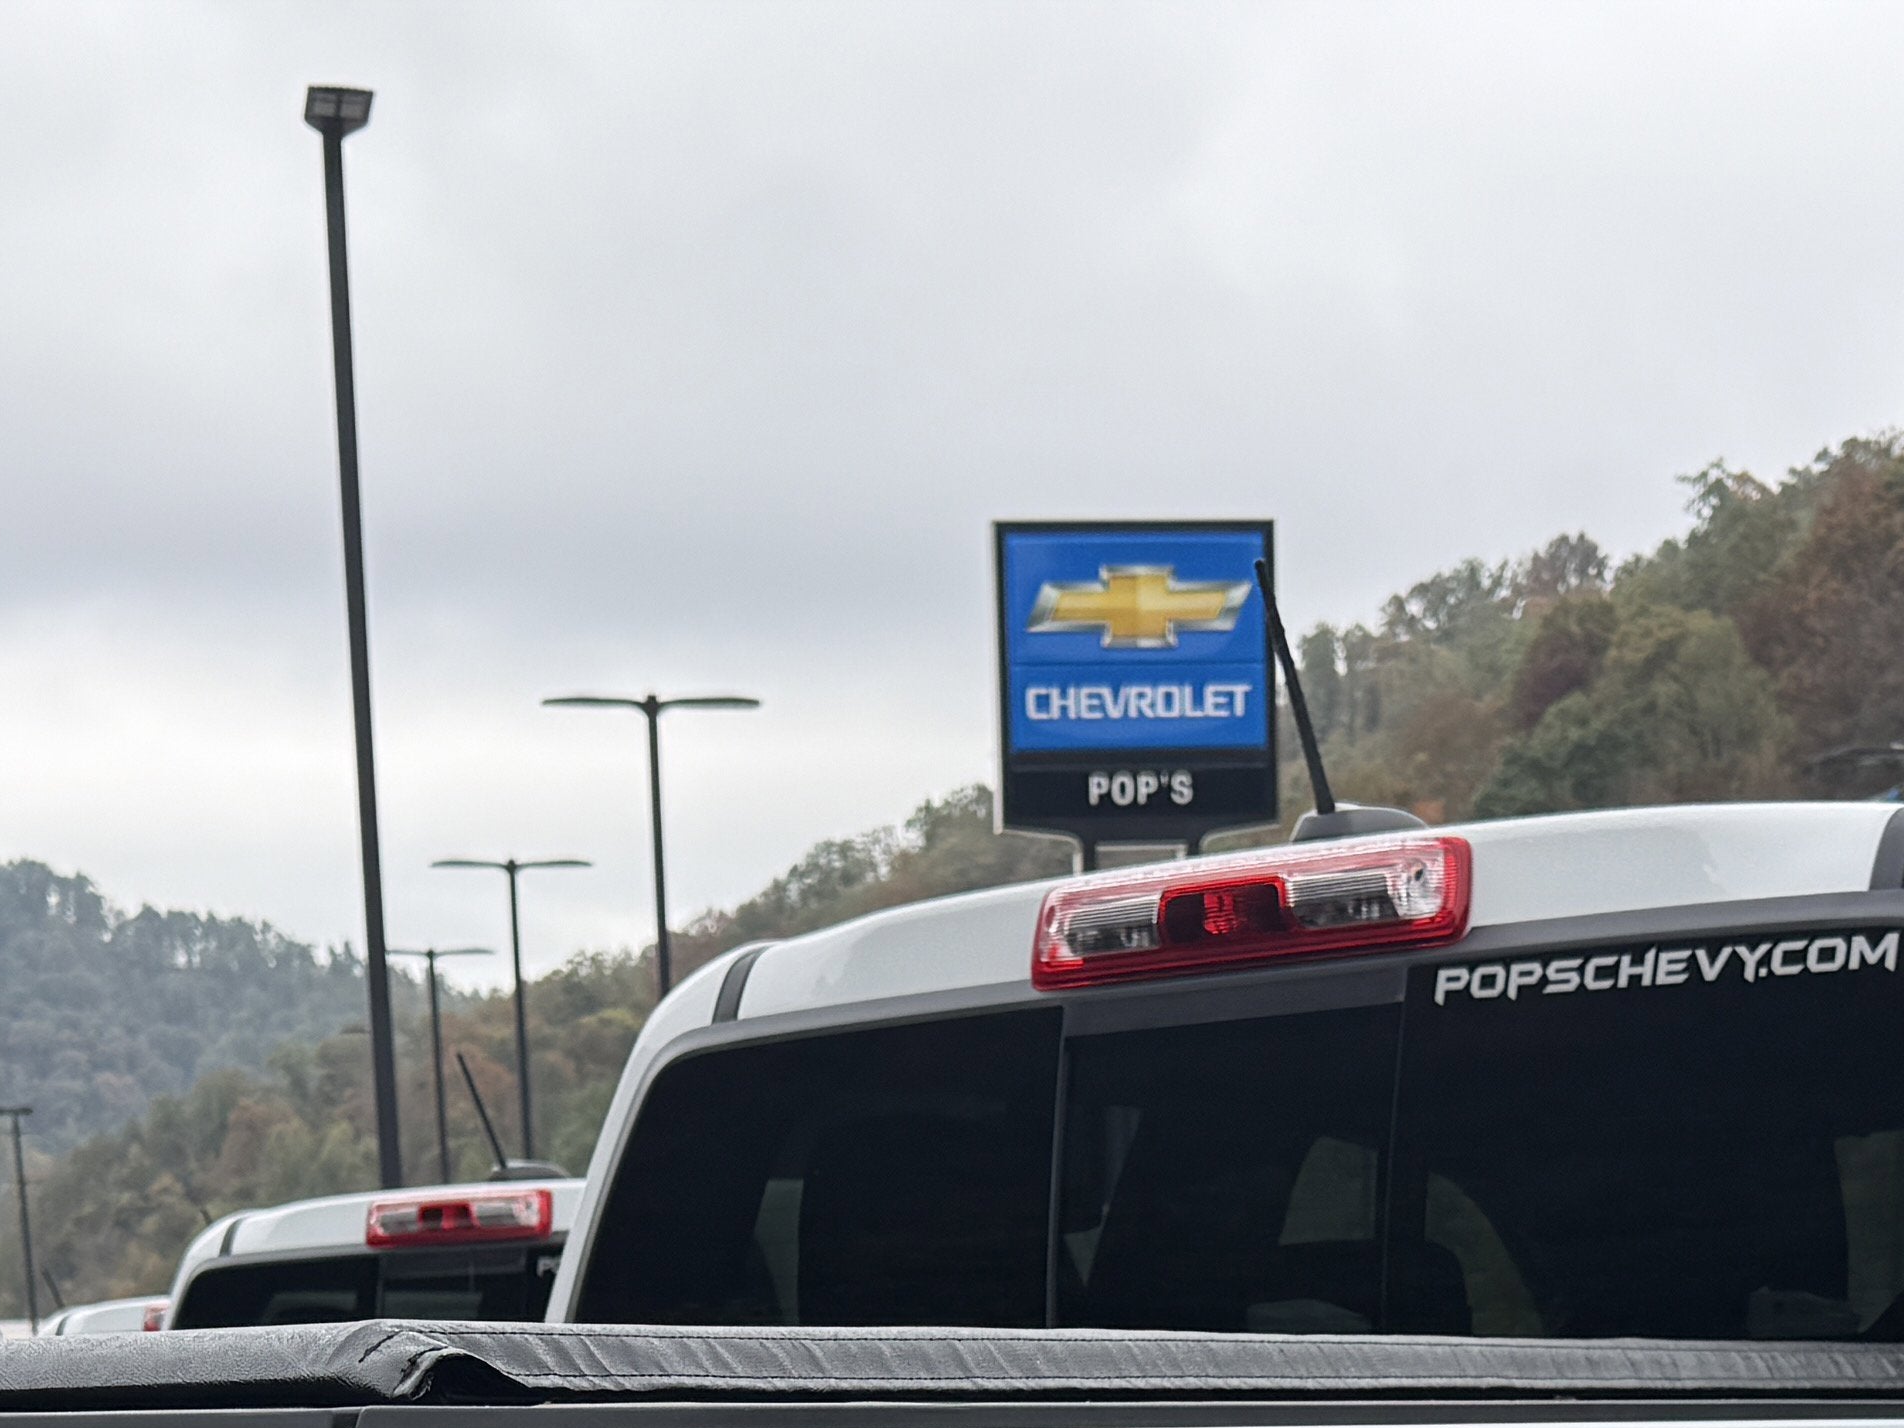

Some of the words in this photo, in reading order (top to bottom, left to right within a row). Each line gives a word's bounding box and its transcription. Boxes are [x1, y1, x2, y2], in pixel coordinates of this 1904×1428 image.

[1024, 681, 1253, 721] CHEVROLET
[1087, 769, 1195, 806] POP'S
[1433, 931, 1902, 1007] POPSCHEVY.COM
